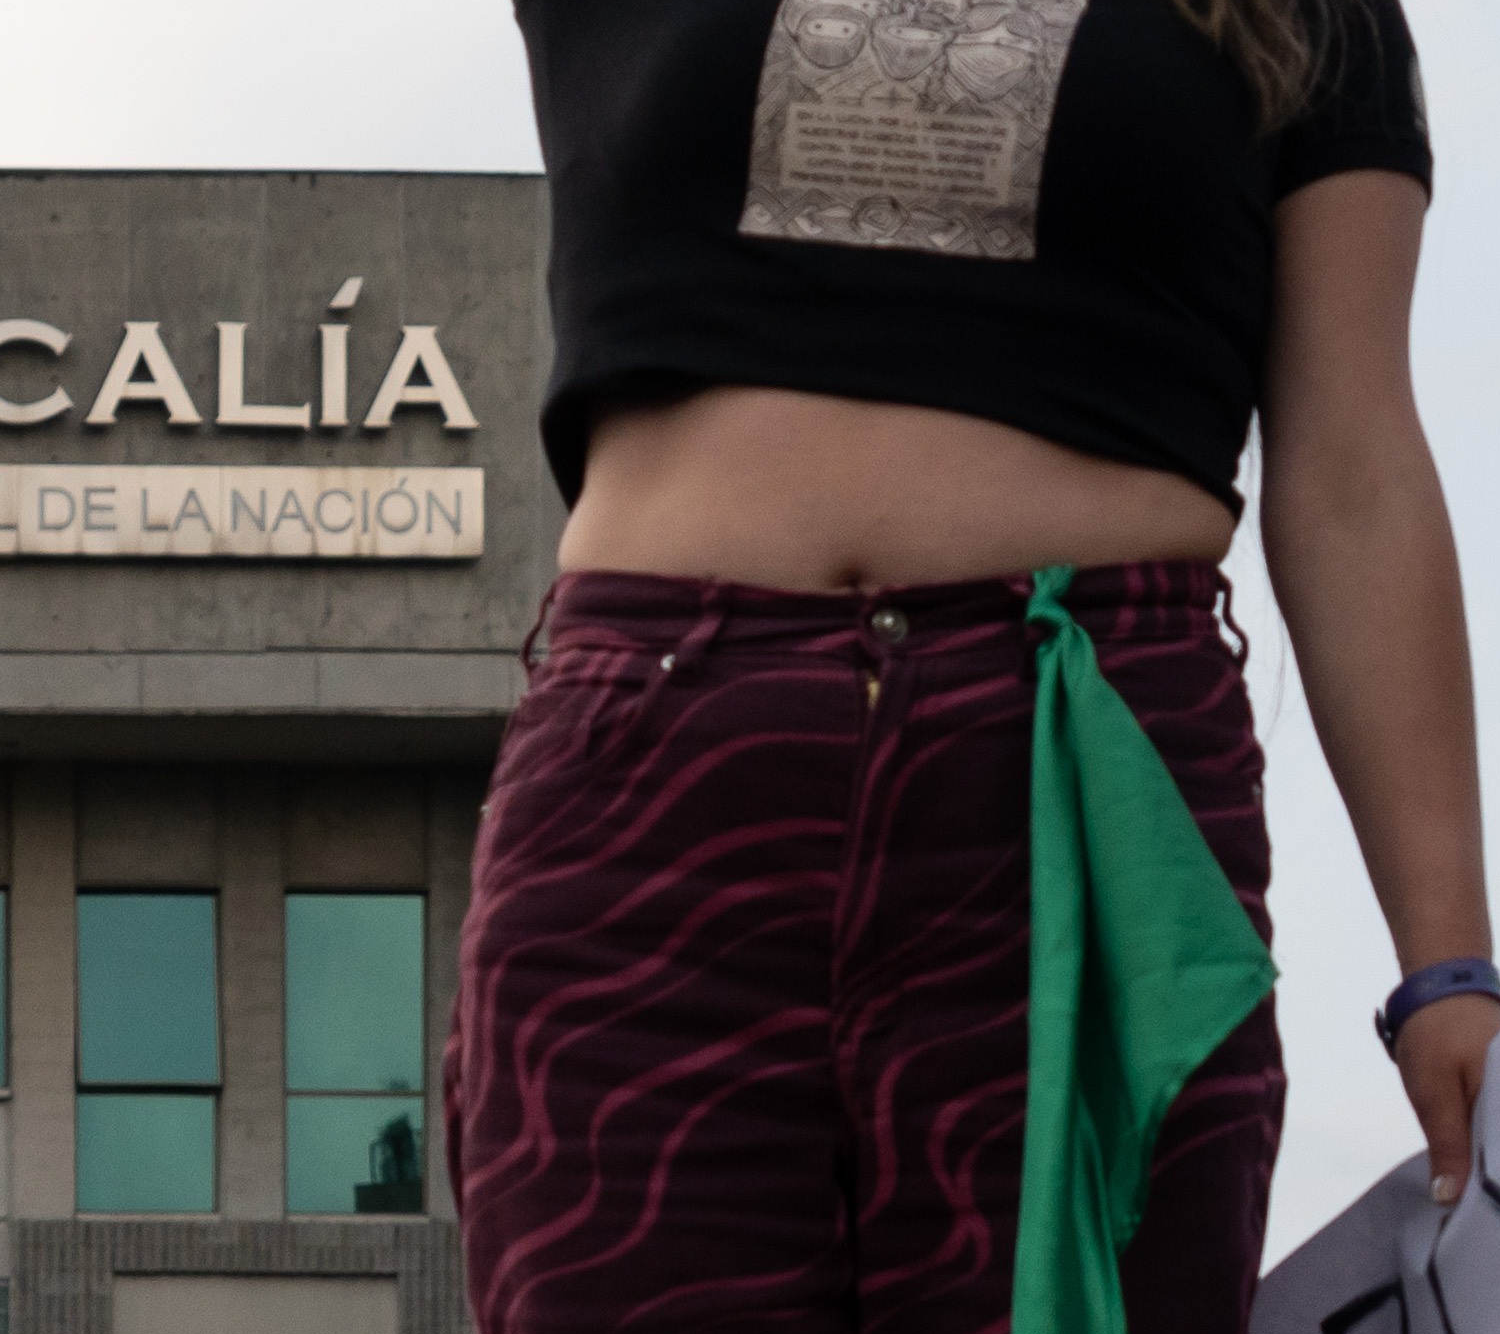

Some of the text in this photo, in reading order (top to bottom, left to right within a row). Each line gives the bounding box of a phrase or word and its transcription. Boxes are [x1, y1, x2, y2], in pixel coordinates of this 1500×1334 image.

[37, 484, 118, 532] DE
[142, 486, 213, 533] LA
[231, 475, 465, 536] NACIÓN
